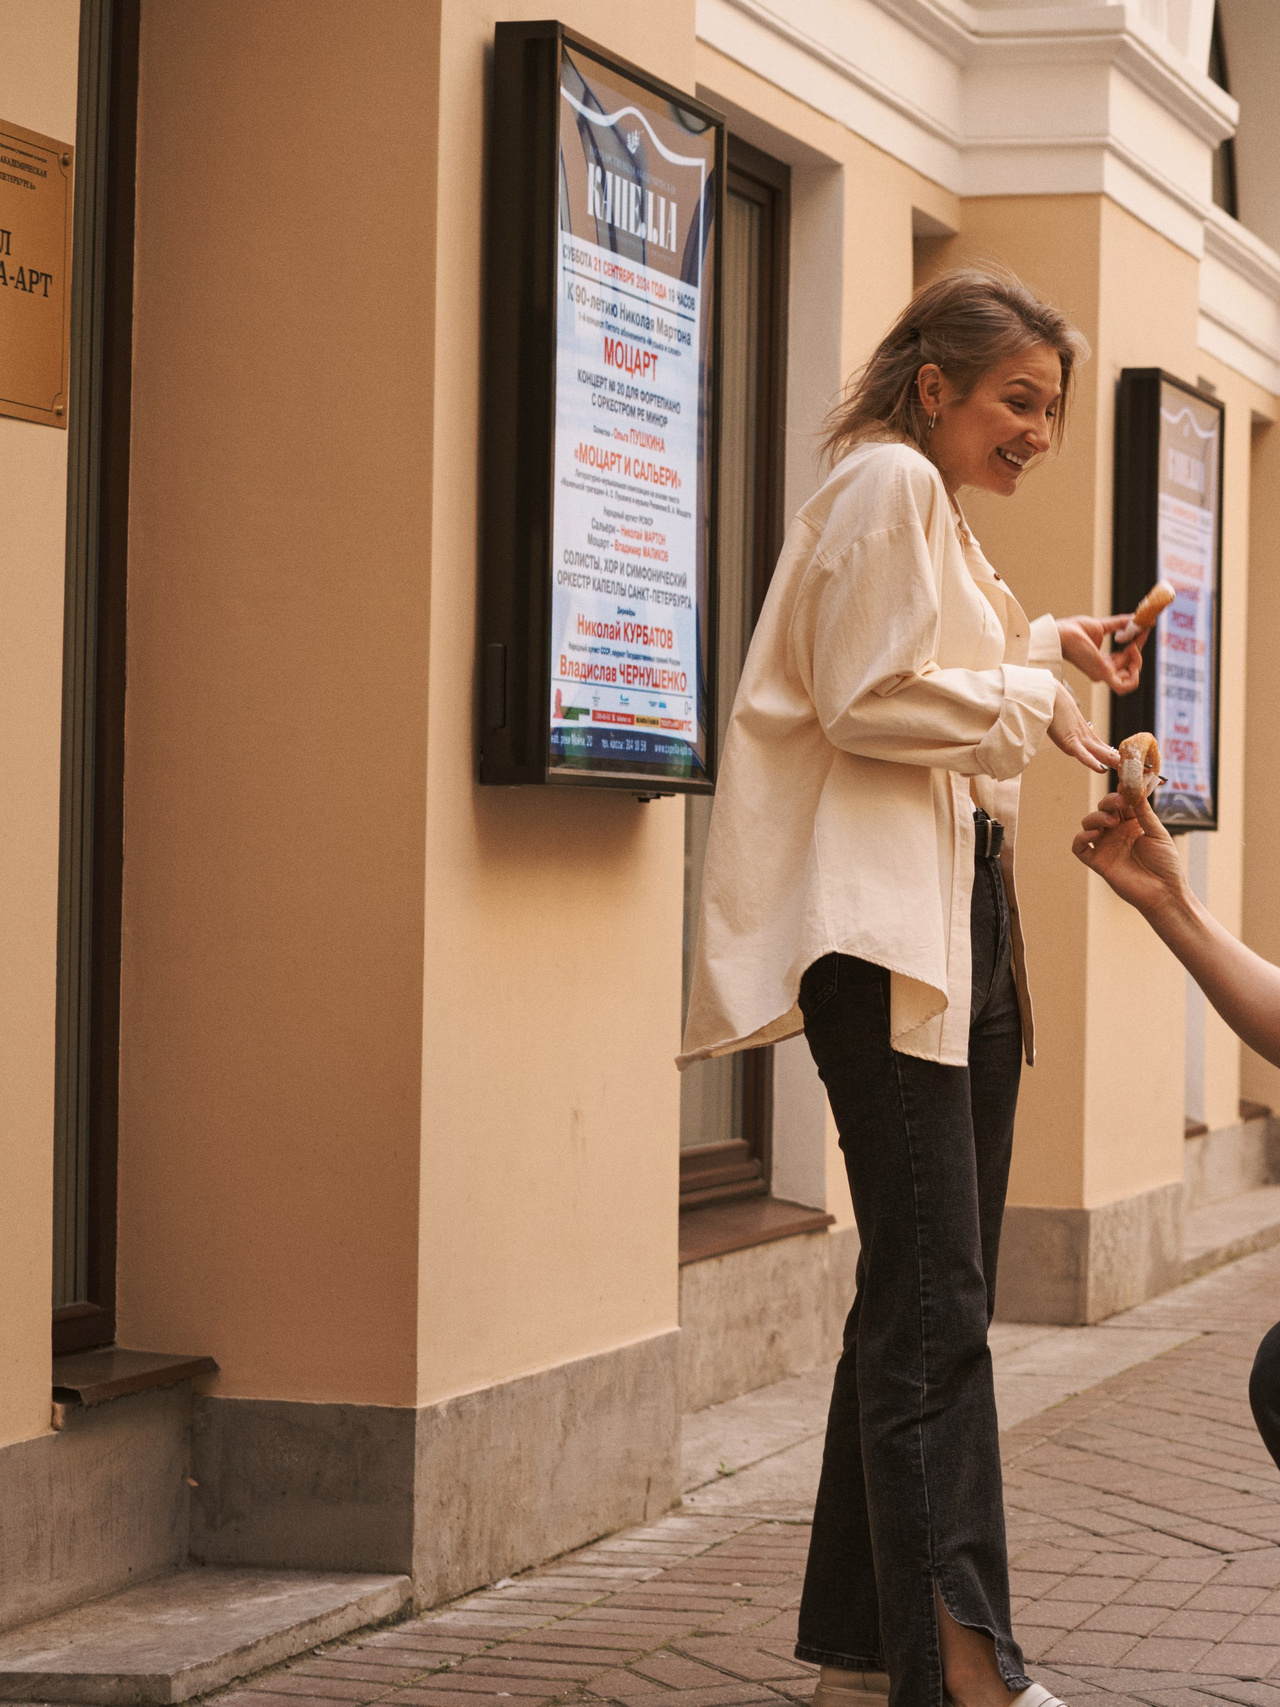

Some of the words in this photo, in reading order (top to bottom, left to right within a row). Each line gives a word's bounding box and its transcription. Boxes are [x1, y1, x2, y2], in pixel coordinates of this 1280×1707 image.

[562, 244, 592, 271] СУББОТА
[594, 256, 602, 273] 21
[603, 261, 635, 286] СЕНТЯБРЯ
[636, 274, 650, 292] 2024
[651, 281, 667, 300] ГОДА
[677, 291, 696, 312] ЧАСОВ
[567, 282, 574, 302] К
[575, 285, 619, 318] 90-летию
[620, 303, 654, 331] Николая
[657, 317, 692, 347] Мартона
[604, 336, 658, 382] МОЦАРТ
[577, 368, 608, 391] КОНЦЕРТ
[609, 380, 616, 392] №
[617, 382, 625, 397] 20
[625, 384, 639, 401] ДЛЯ
[640, 391, 681, 415] ФОРТЕПИАНО
[591, 393, 597, 406] С
[597, 394, 637, 419] ОРКЕСТРОМ
[637, 407, 645, 422] РЕ
[646, 409, 669, 428] МИНОР
[630, 428, 666, 453] ПУШКИНА
[574, 442, 622, 473] «МОЦАРТ
[624, 457, 631, 476] И
[633, 458, 682, 489] САЛЬЕРИ»
[587, 533, 610, 549] Моцарт
[642, 545, 669, 562] МАЛИКОВ
[591, 517, 616, 534] Сальери
[621, 524, 643, 541] Николай
[644, 530, 666, 545] МАРТОН
[563, 549, 603, 574] СОЛИСТЫ,
[603, 557, 619, 574] ХОР
[619, 560, 625, 575] И
[626, 562, 687, 588] СИМФОНИЧЕСКИЙ
[557, 570, 591, 590] ОРКЕСТР
[592, 576, 627, 597] КАПЕЛЛЫ
[628, 583, 692, 610] САНКТ-ПЕТЕРБУРГА
[577, 613, 621, 641] Николай
[623, 621, 673, 649] КУРБАТОВ
[560, 654, 617, 684] Владислав
[619, 663, 687, 693] ЧЕРНУШЕНКО
